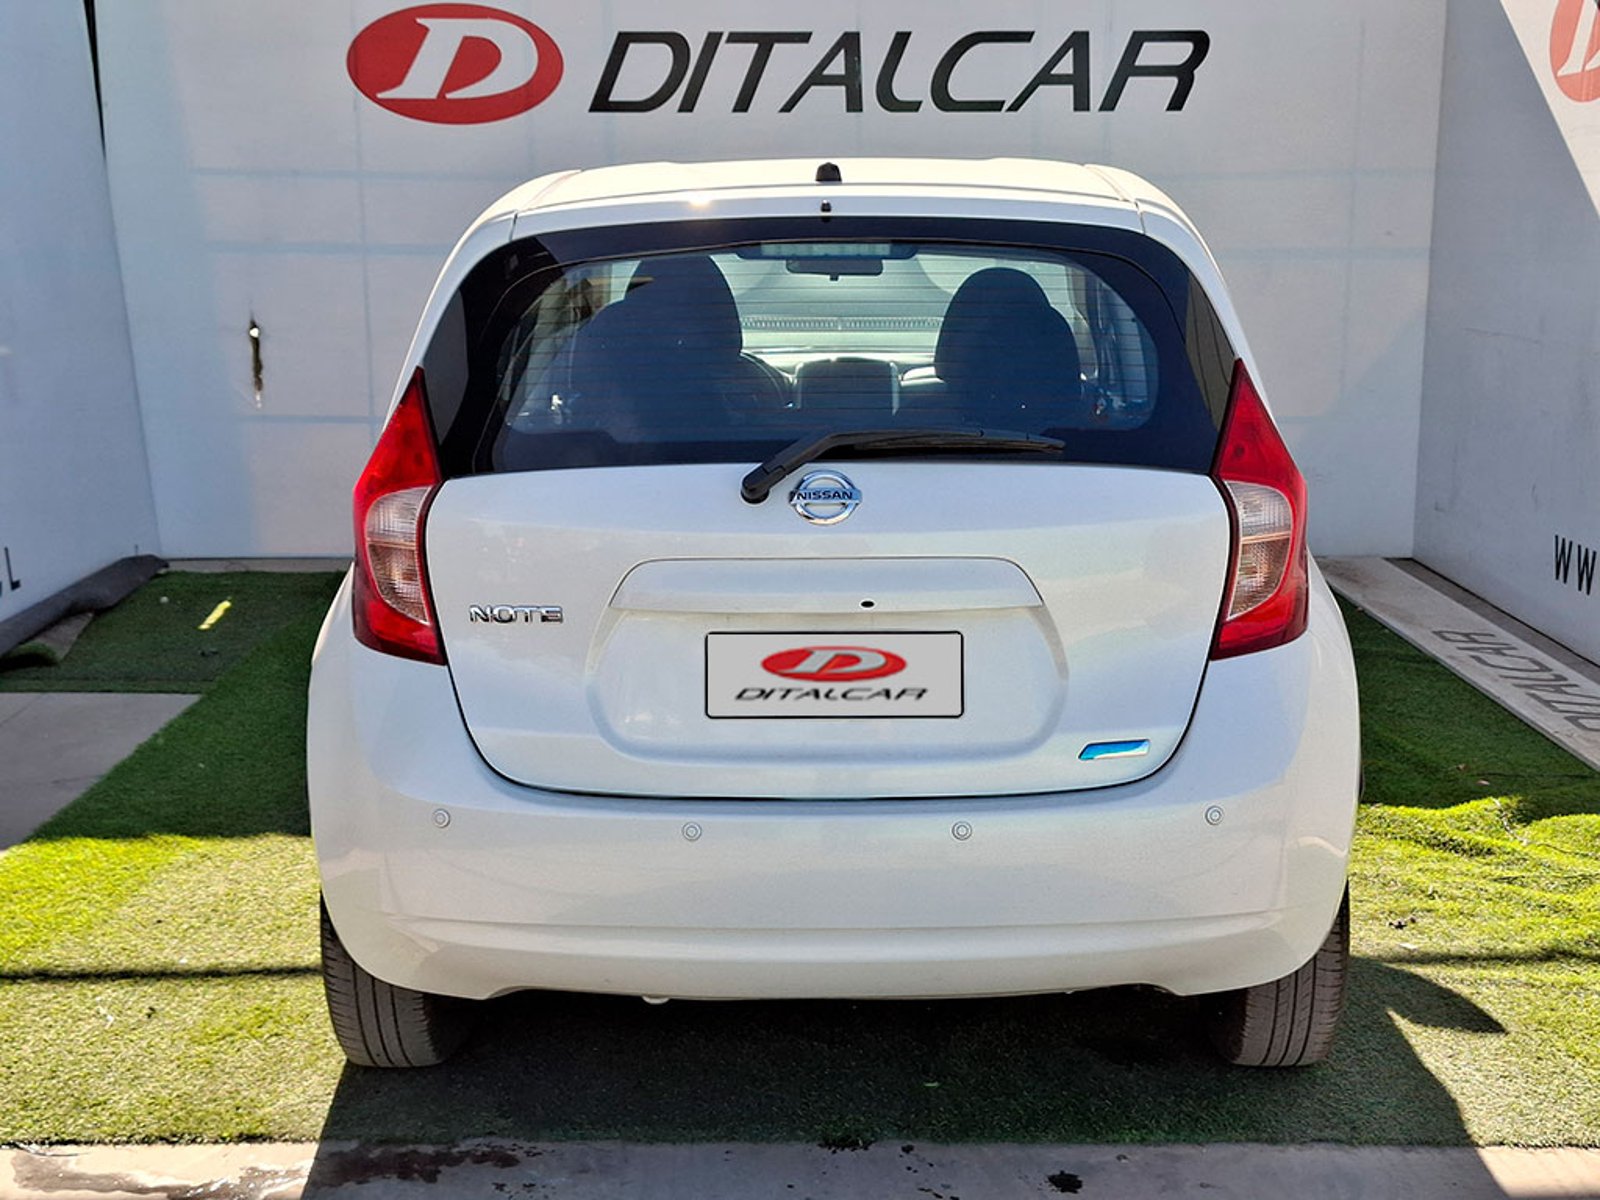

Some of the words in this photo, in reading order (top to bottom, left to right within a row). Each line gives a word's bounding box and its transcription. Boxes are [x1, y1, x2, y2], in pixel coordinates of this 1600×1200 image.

[375, 17, 539, 100] D
[588, 30, 1211, 113] DITALCAR
[796, 490, 853, 501] NISSAN
[469, 604, 564, 624] NOTE
